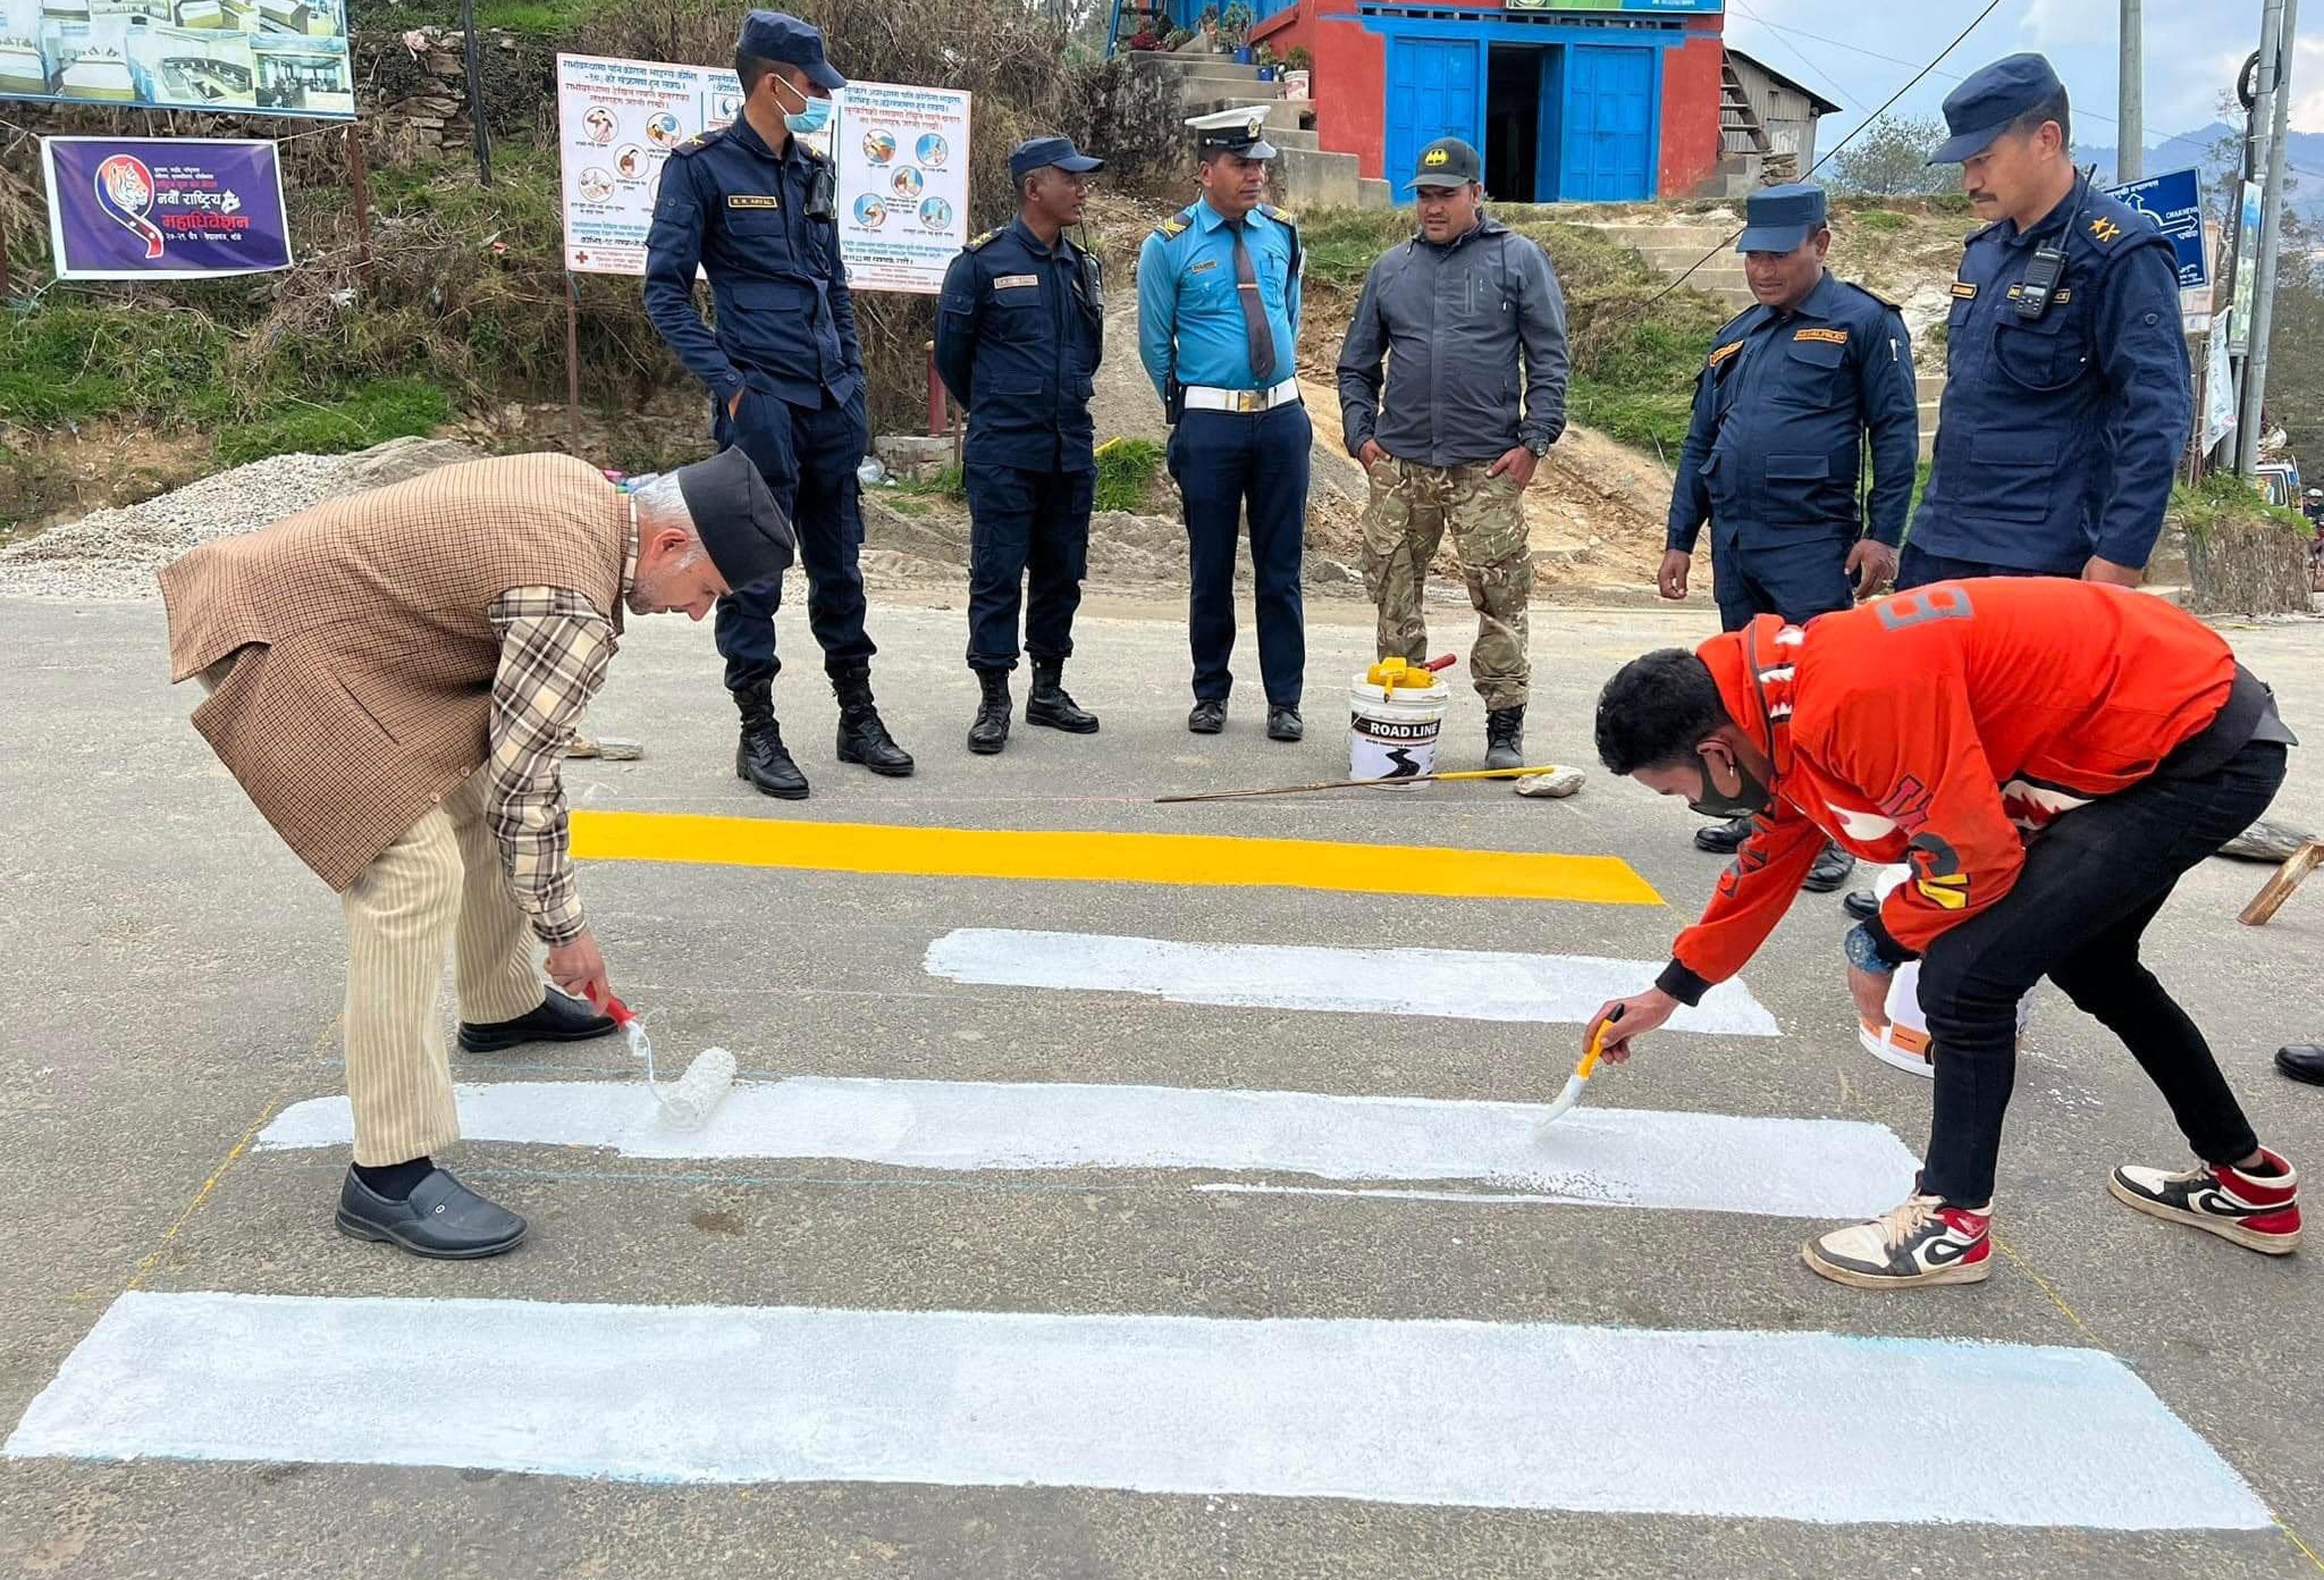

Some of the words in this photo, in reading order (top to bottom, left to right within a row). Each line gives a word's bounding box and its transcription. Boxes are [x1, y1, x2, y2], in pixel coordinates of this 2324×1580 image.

[162, 210, 250, 231] महाधिवेशन
[1370, 722, 1411, 737] ROAD
[1413, 722, 1437, 736] LINE
